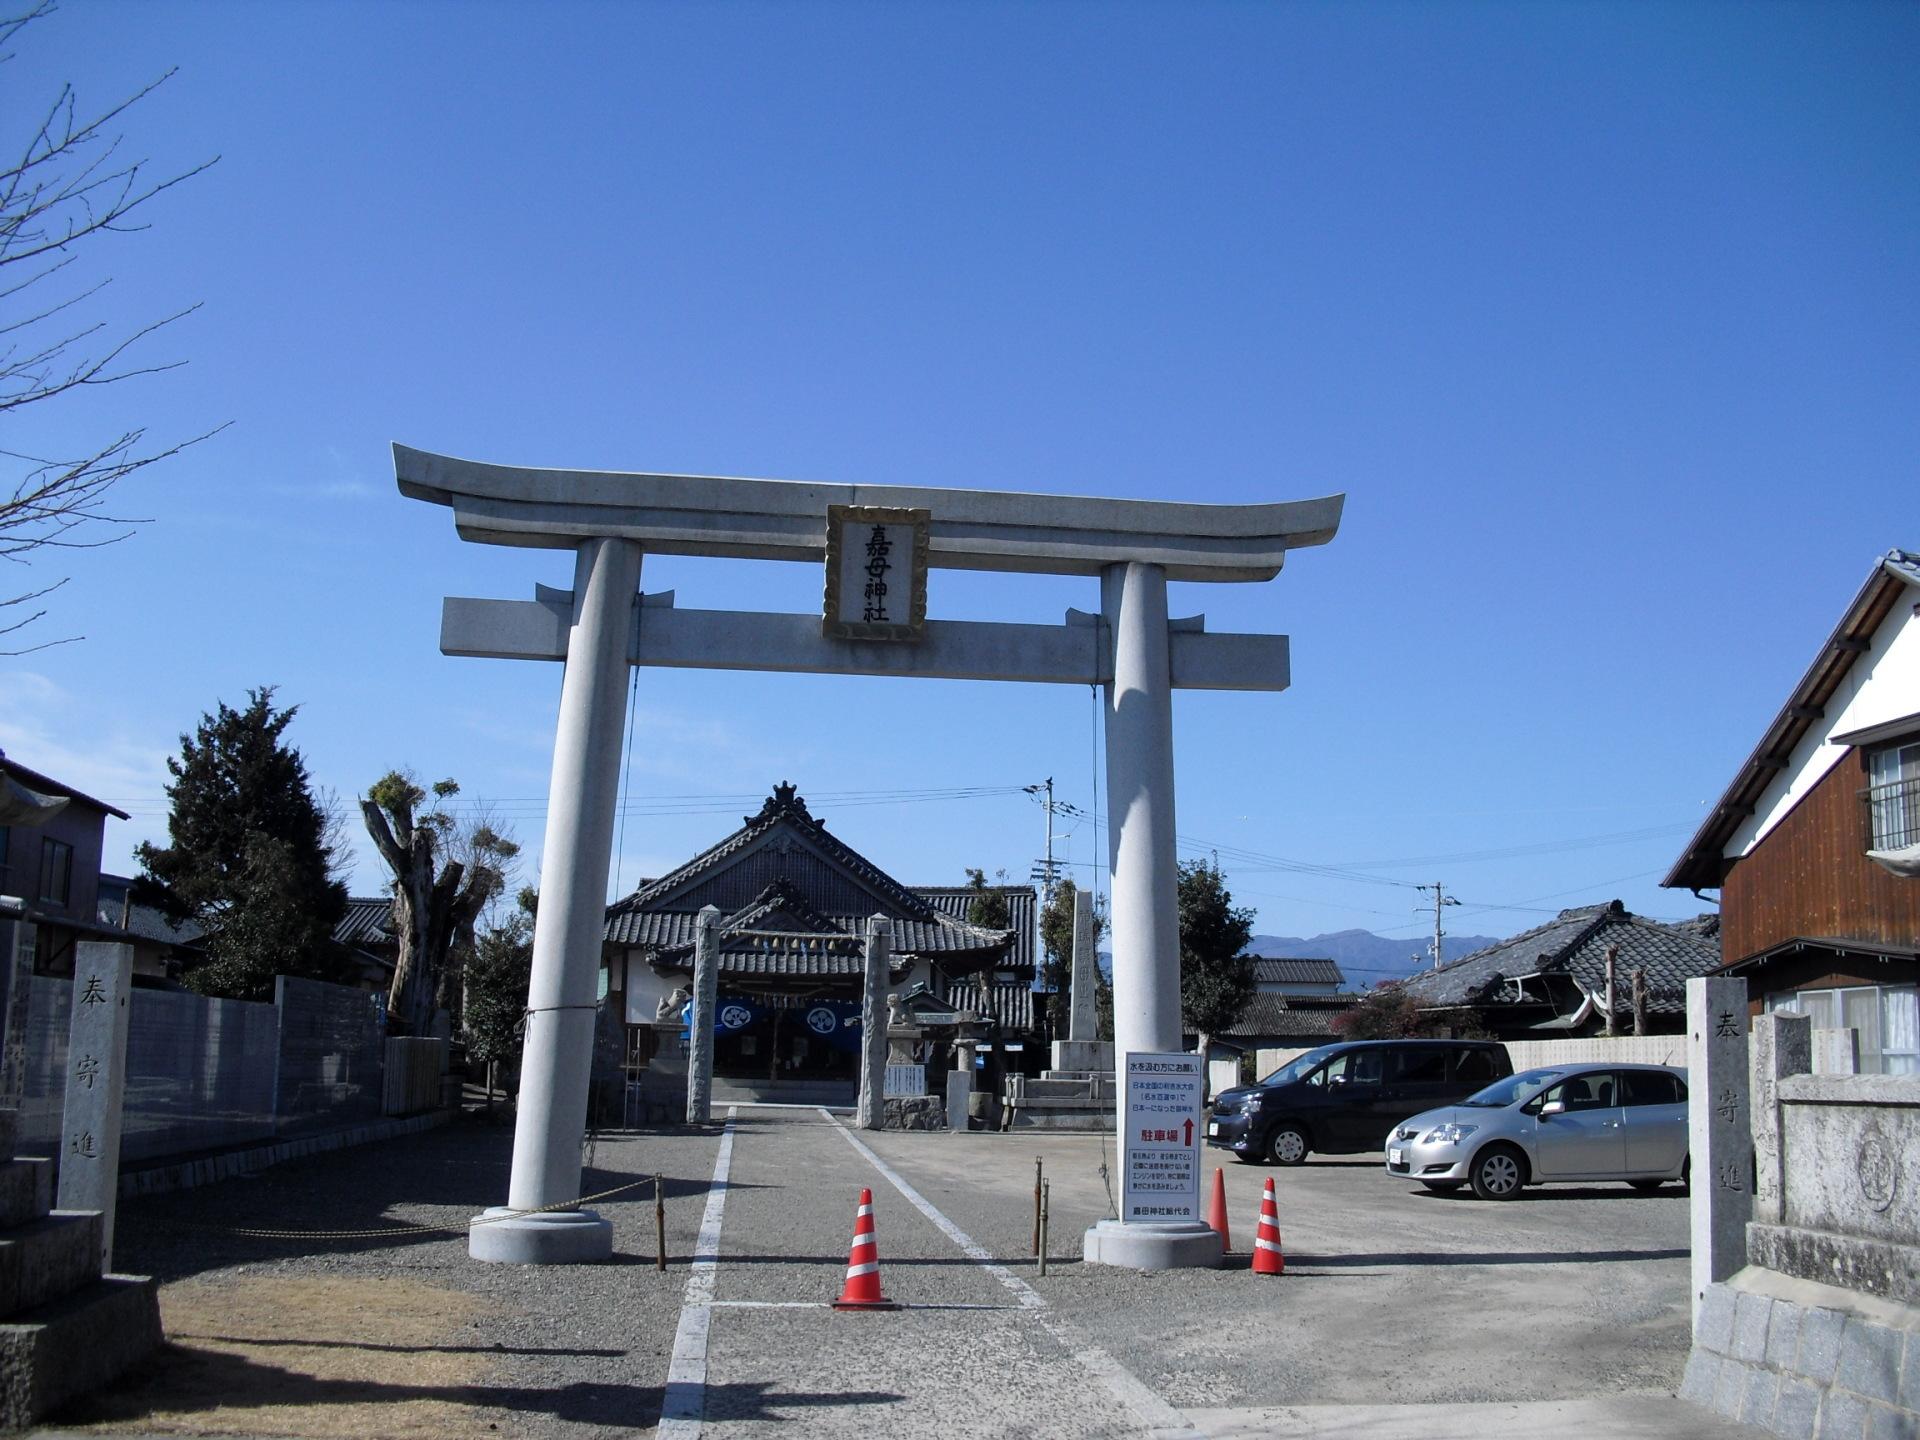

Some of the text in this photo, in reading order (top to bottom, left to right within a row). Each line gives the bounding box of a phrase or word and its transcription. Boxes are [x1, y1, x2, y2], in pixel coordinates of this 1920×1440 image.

[863, 523, 893, 624] 嘉母神社
[71, 974, 107, 1160] 奉寄進
[1130, 1062, 1198, 1073] 水を汲む方にお願い
[1715, 1010, 1743, 1192] 奉寄進
[1141, 1129, 1178, 1142] 駐車場
